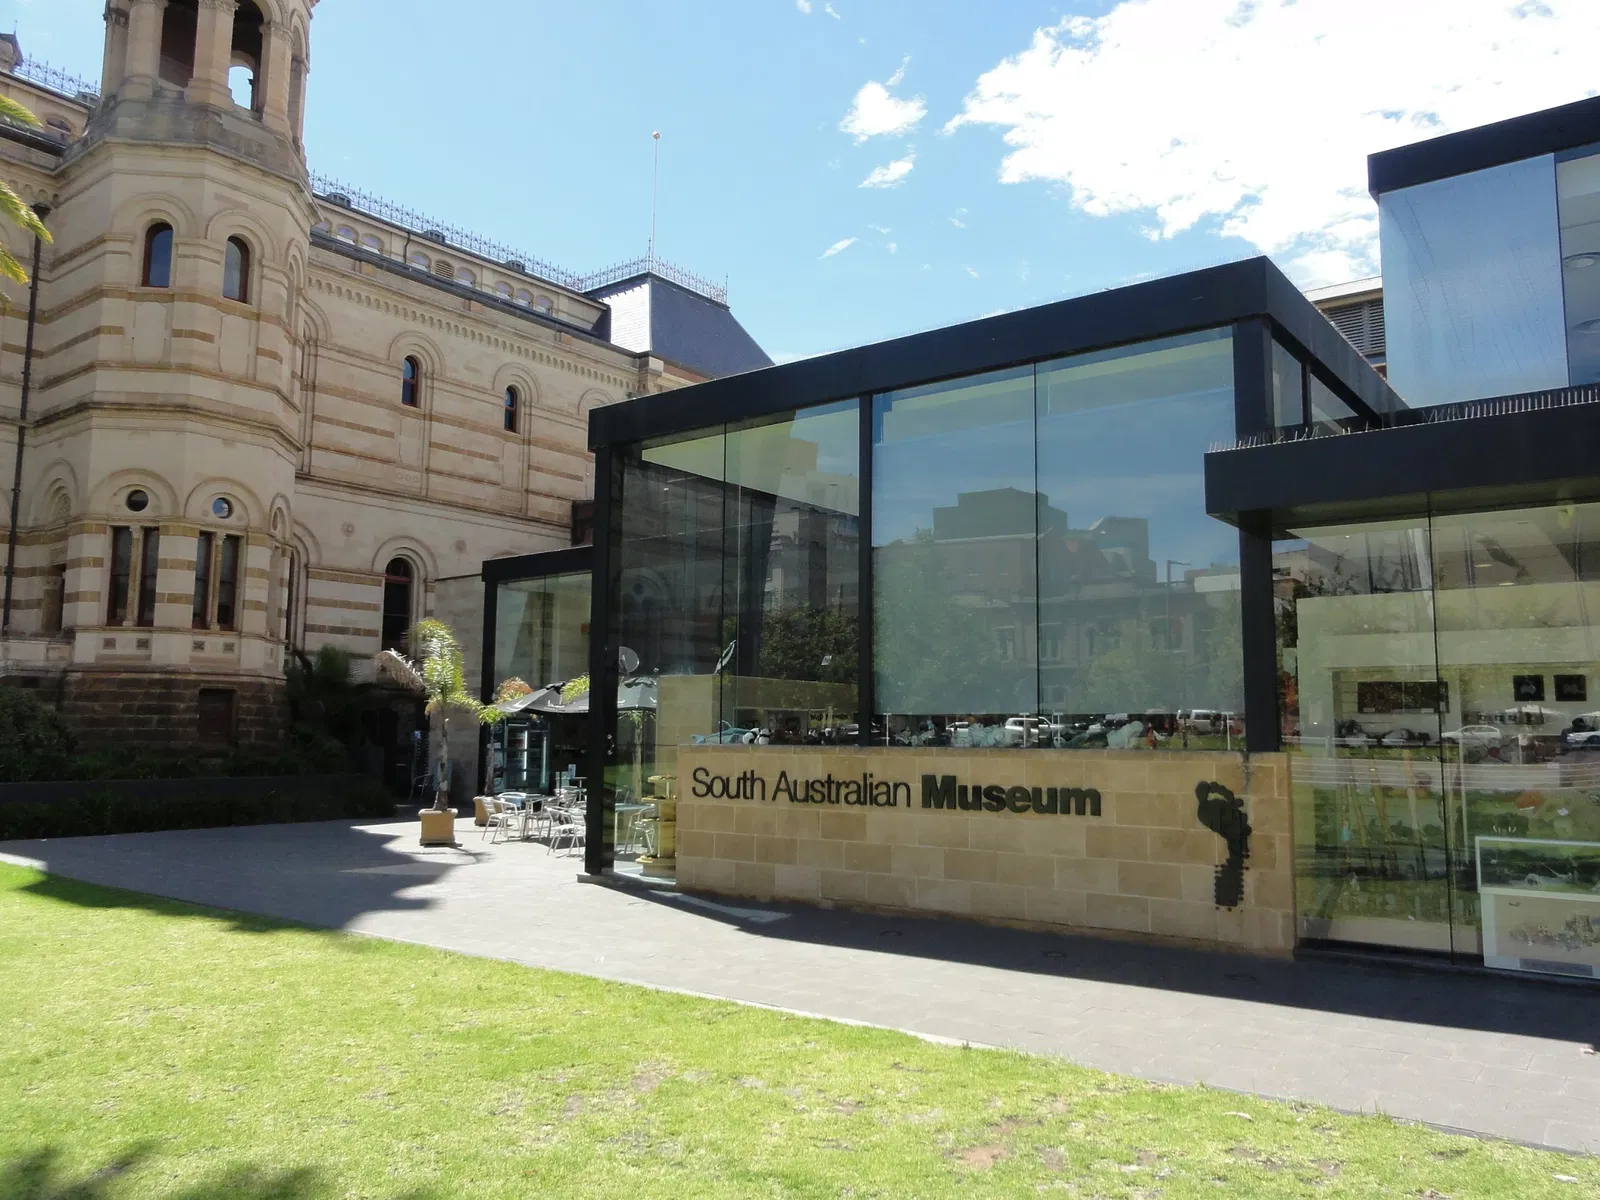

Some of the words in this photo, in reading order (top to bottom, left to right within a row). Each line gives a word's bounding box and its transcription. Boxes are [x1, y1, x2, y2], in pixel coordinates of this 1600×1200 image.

[692, 767, 765, 801] South
[772, 770, 910, 808] Australian
[921, 774, 1101, 816] Museum
